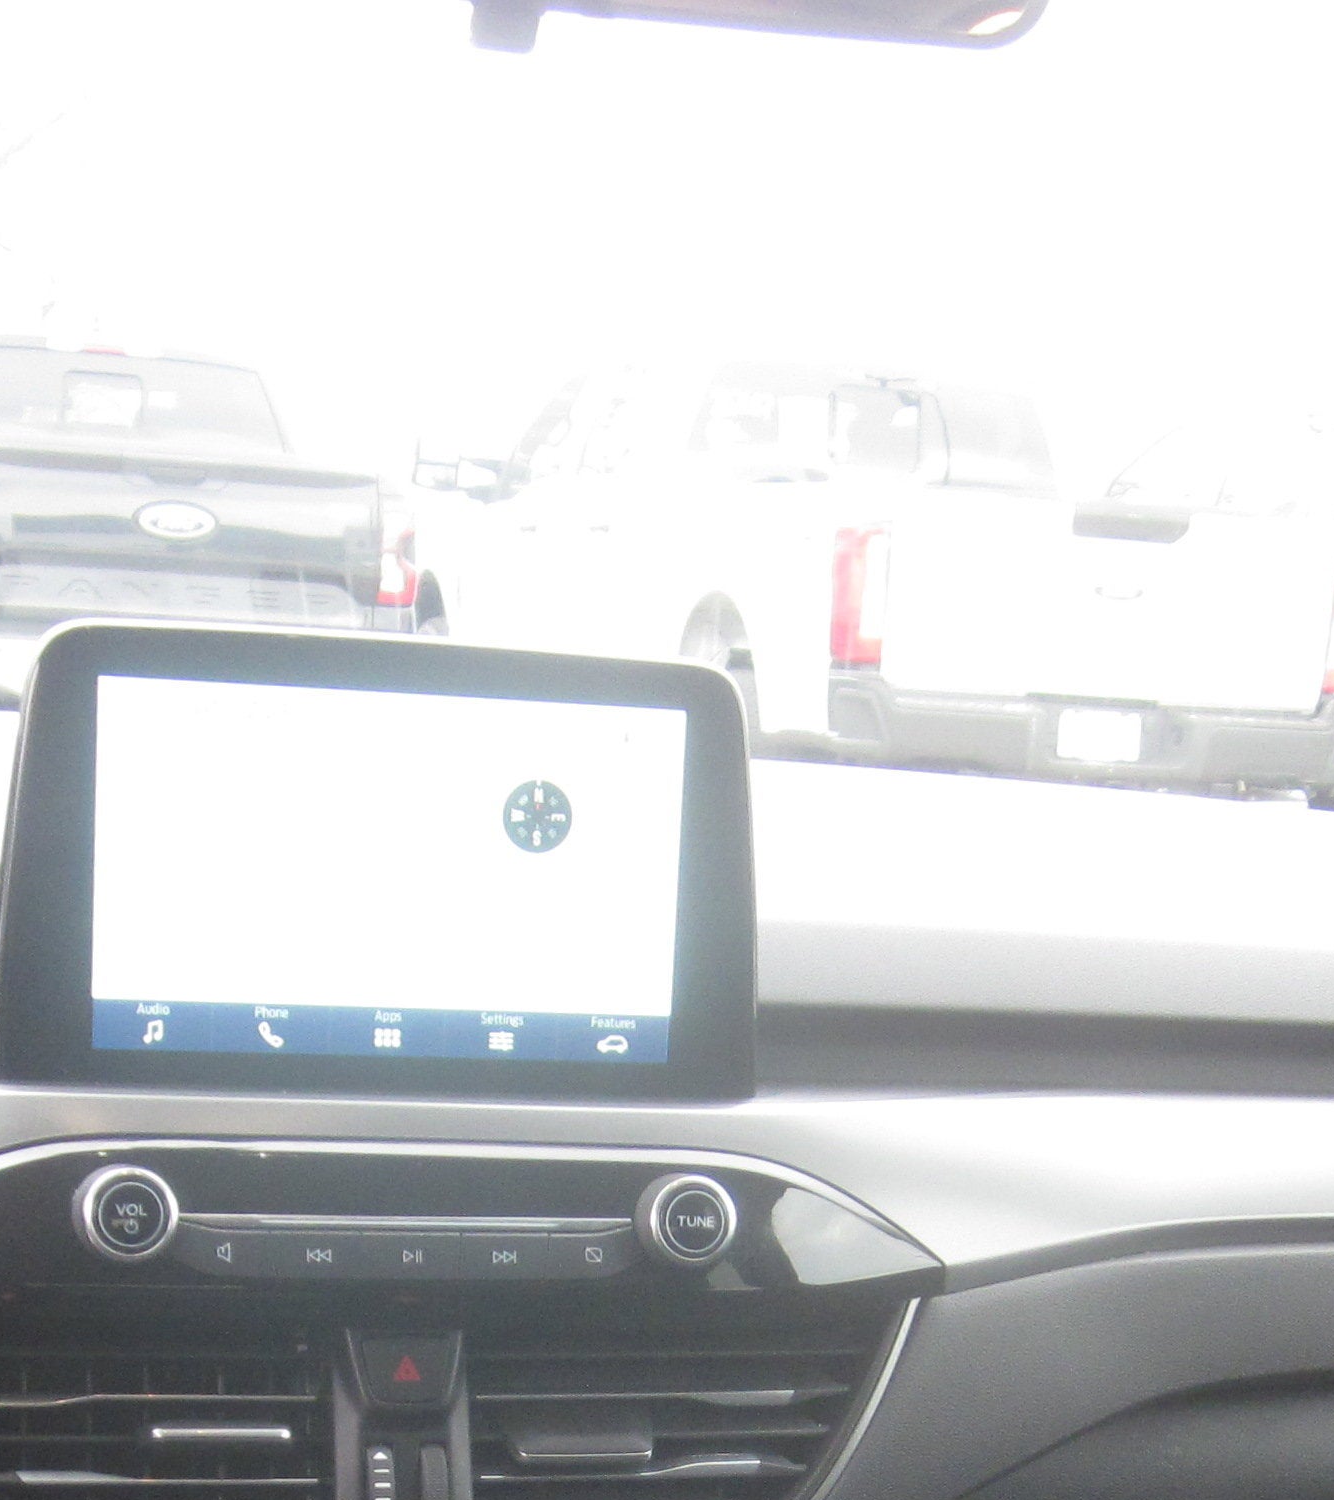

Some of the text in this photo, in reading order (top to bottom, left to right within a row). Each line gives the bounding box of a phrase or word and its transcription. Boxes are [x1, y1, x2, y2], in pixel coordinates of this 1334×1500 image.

[136, 1003, 171, 1015] Audio
[255, 1006, 289, 1020] Phone
[374, 1010, 402, 1024] Apps
[481, 1012, 524, 1028] Settings
[591, 1016, 636, 1030] Features
[115, 1203, 147, 1217] VOL
[677, 1215, 715, 1228] TUNE
